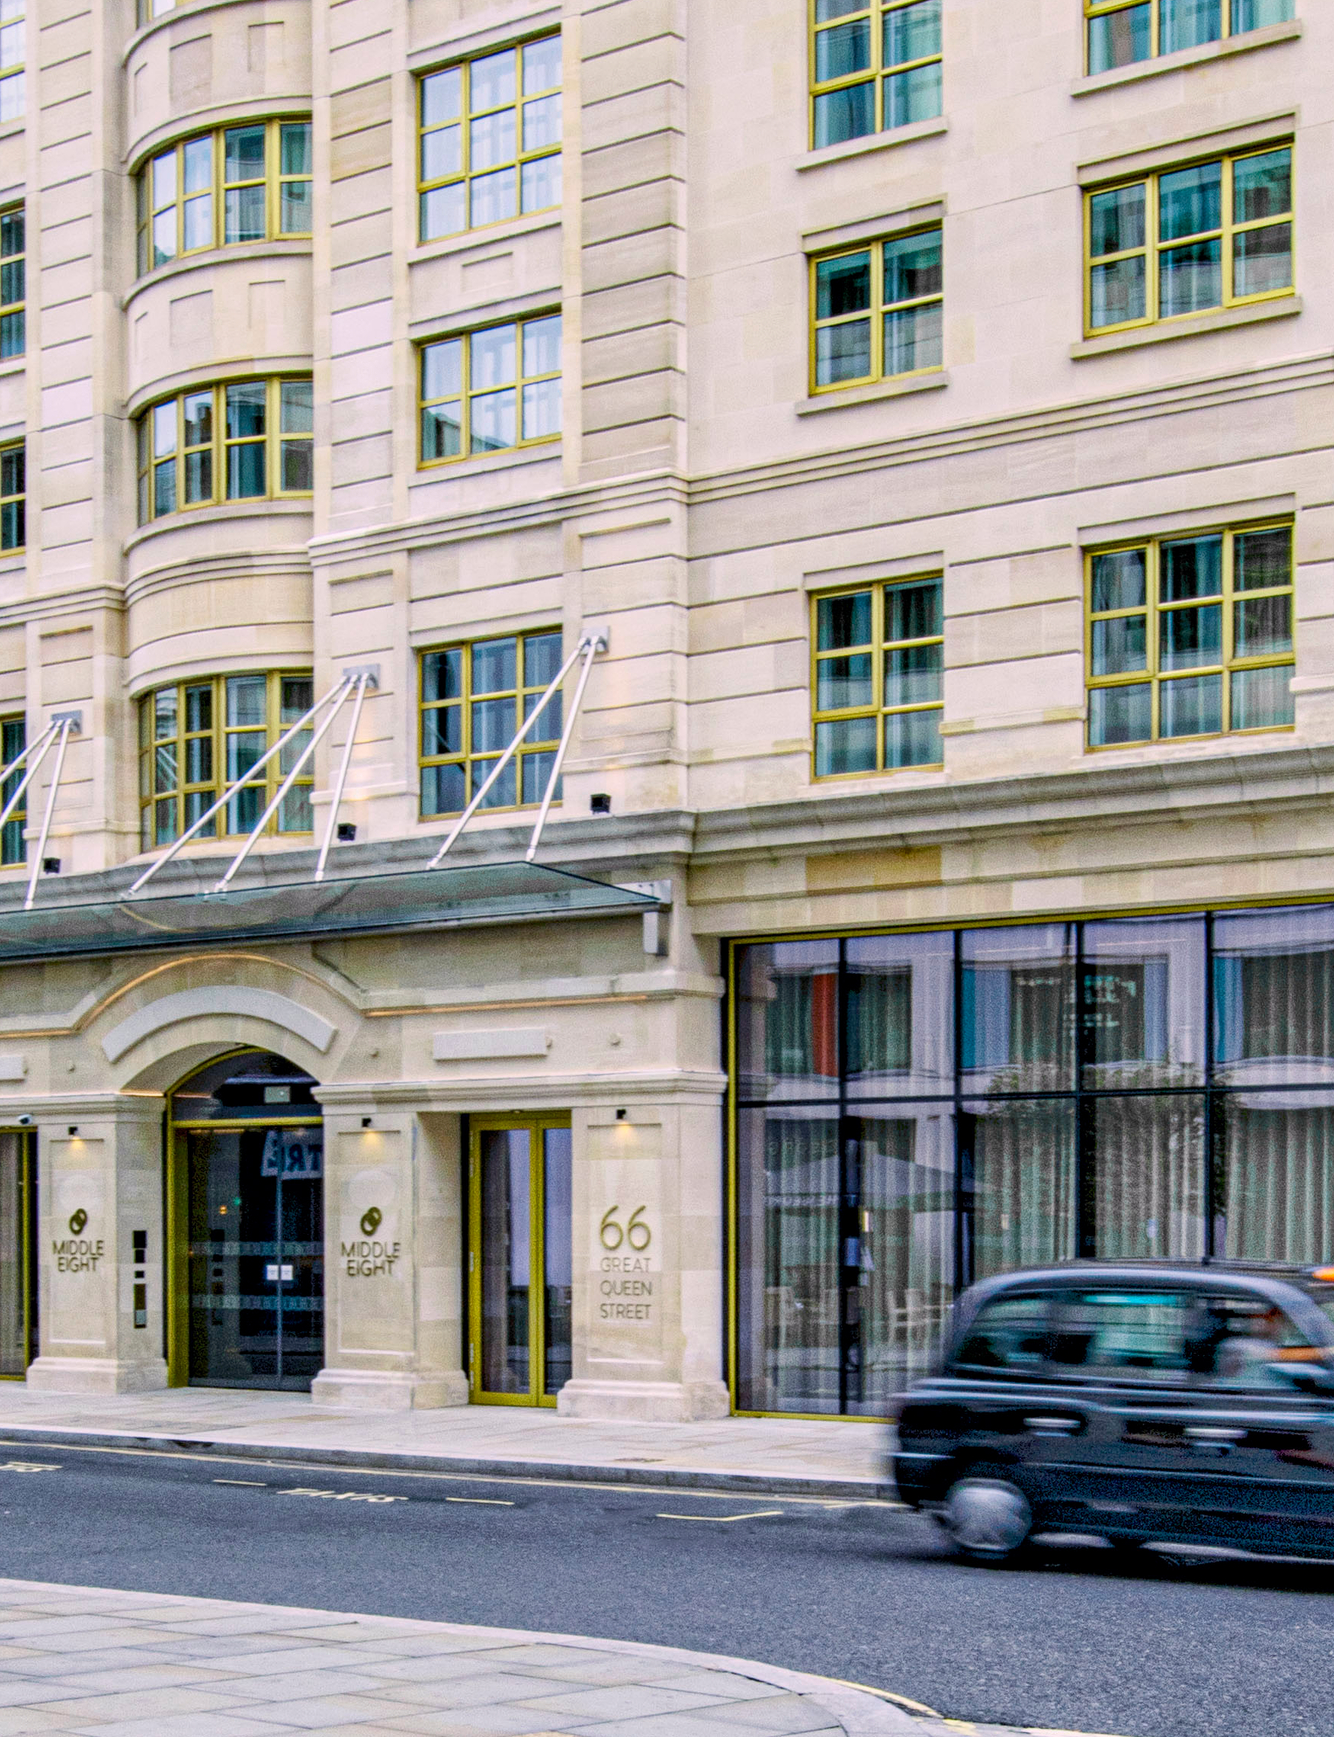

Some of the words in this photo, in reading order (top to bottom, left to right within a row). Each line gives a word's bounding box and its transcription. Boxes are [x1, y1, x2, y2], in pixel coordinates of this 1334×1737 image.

[599, 1205, 652, 1251] 66
[52, 1239, 104, 1256] MIDDLE
[341, 1241, 401, 1258] MIDDLE
[58, 1256, 99, 1272] EIGHT
[347, 1259, 395, 1277] EIGHT
[600, 1257, 652, 1272] GREAT
[600, 1280, 652, 1298] QUEEN
[599, 1303, 652, 1319] STREET
